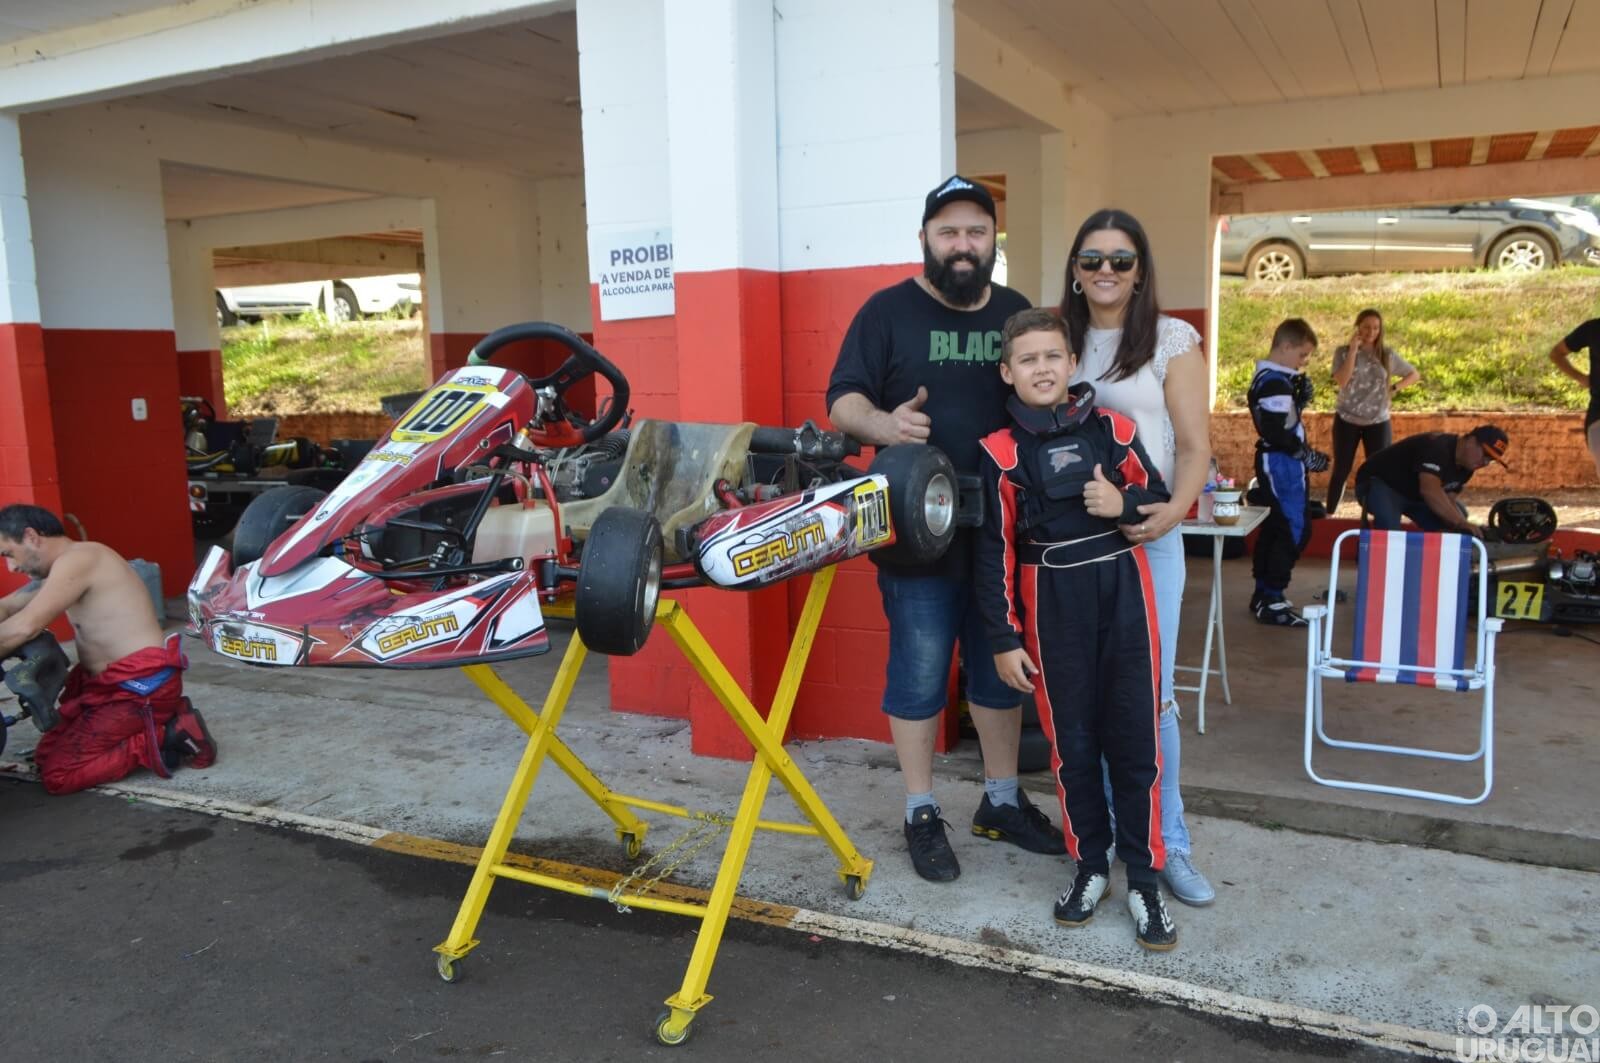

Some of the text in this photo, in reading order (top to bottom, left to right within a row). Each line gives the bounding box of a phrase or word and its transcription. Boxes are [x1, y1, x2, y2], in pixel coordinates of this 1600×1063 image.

[601, 267, 671, 285] A VENDA DE
[602, 284, 650, 297] ALCOÓLICA
[732, 520, 826, 577] CERUTTI
[1501, 584, 1539, 616] 27
[221, 635, 277, 661] CERUTTI
[378, 614, 459, 654] CERUTTI
